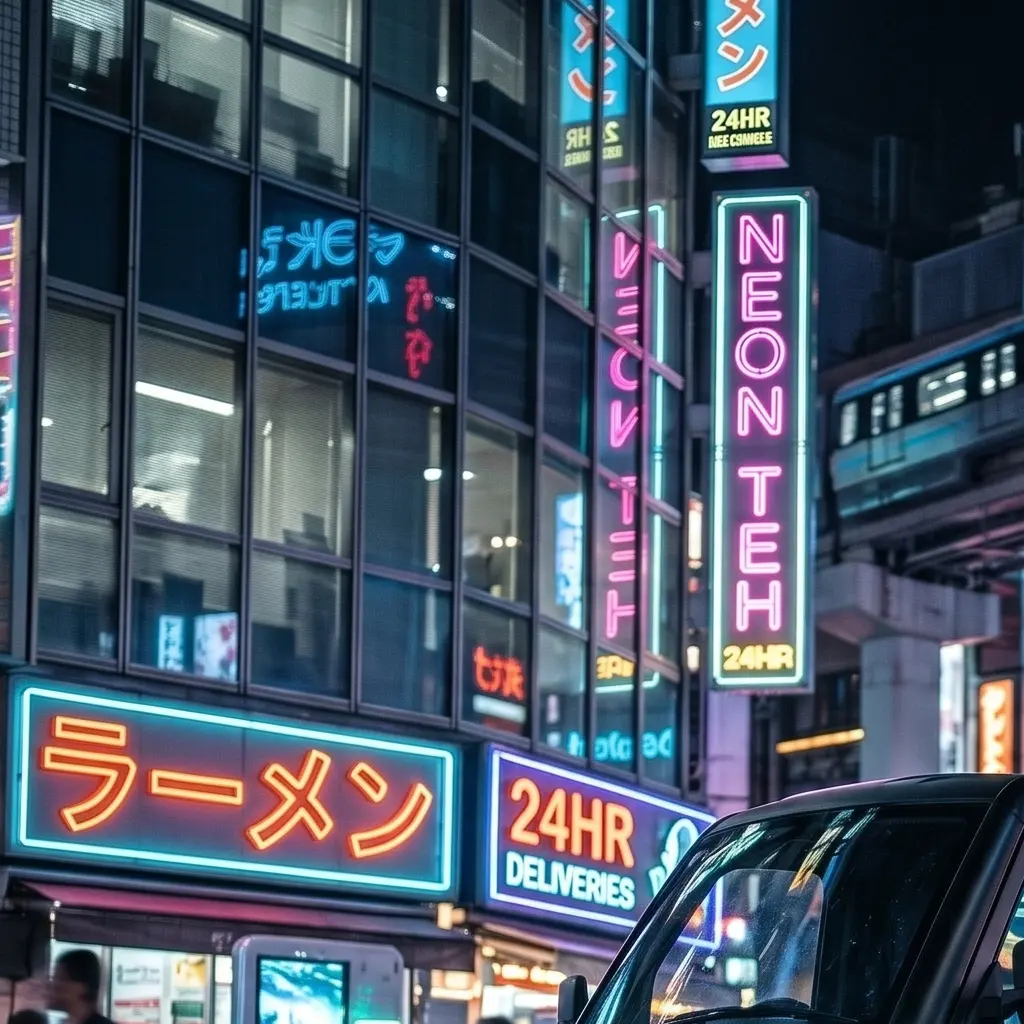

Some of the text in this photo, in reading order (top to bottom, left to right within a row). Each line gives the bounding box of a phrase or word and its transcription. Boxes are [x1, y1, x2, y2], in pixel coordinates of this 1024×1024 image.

[711, 106, 771, 133] 24HR
[735, 213, 785, 632] NEON TEH
[723, 643, 795, 672] 24HR
[41, 715, 433, 859] ラーメン
[510, 777, 635, 868] 24HR
[506, 850, 636, 910] DELIVERIES
